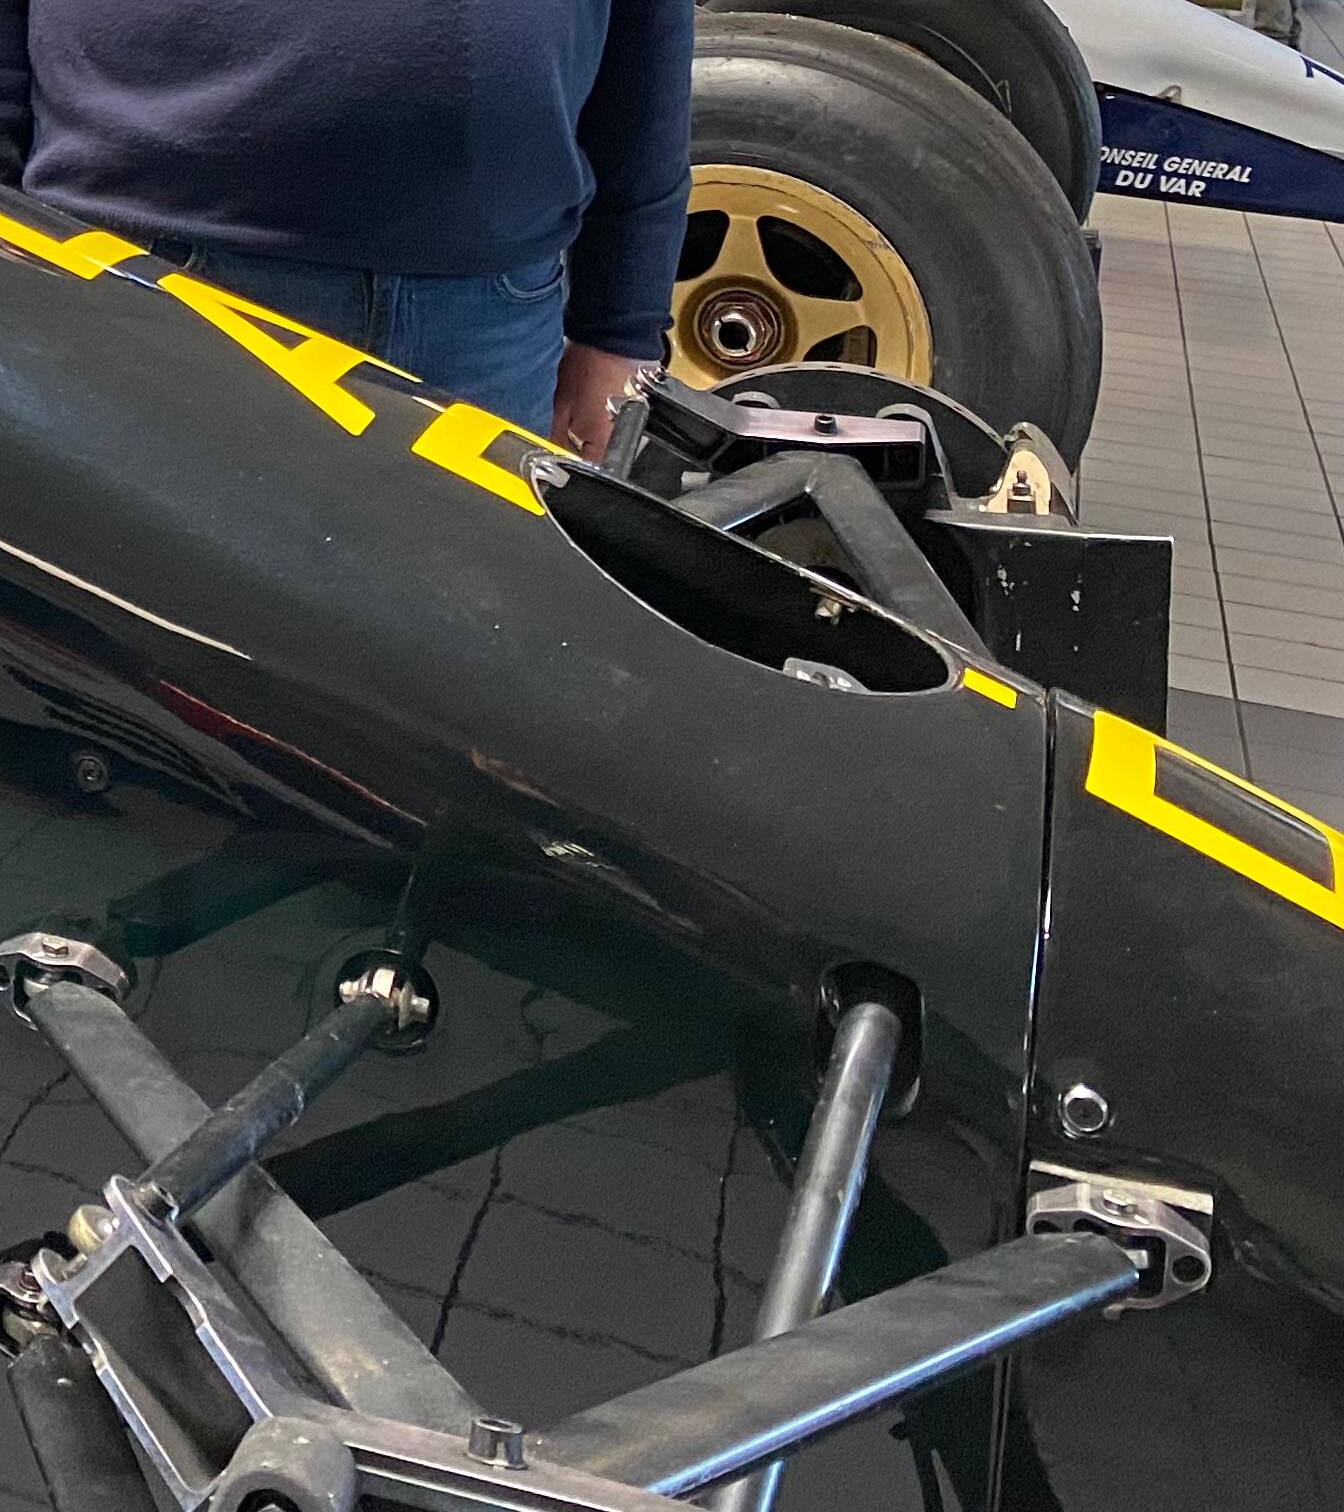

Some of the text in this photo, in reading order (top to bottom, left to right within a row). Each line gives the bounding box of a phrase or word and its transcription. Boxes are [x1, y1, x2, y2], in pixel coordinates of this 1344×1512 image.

[1114, 169, 1208, 199] DU VAR
[1162, 155, 1254, 184] GENERAL
